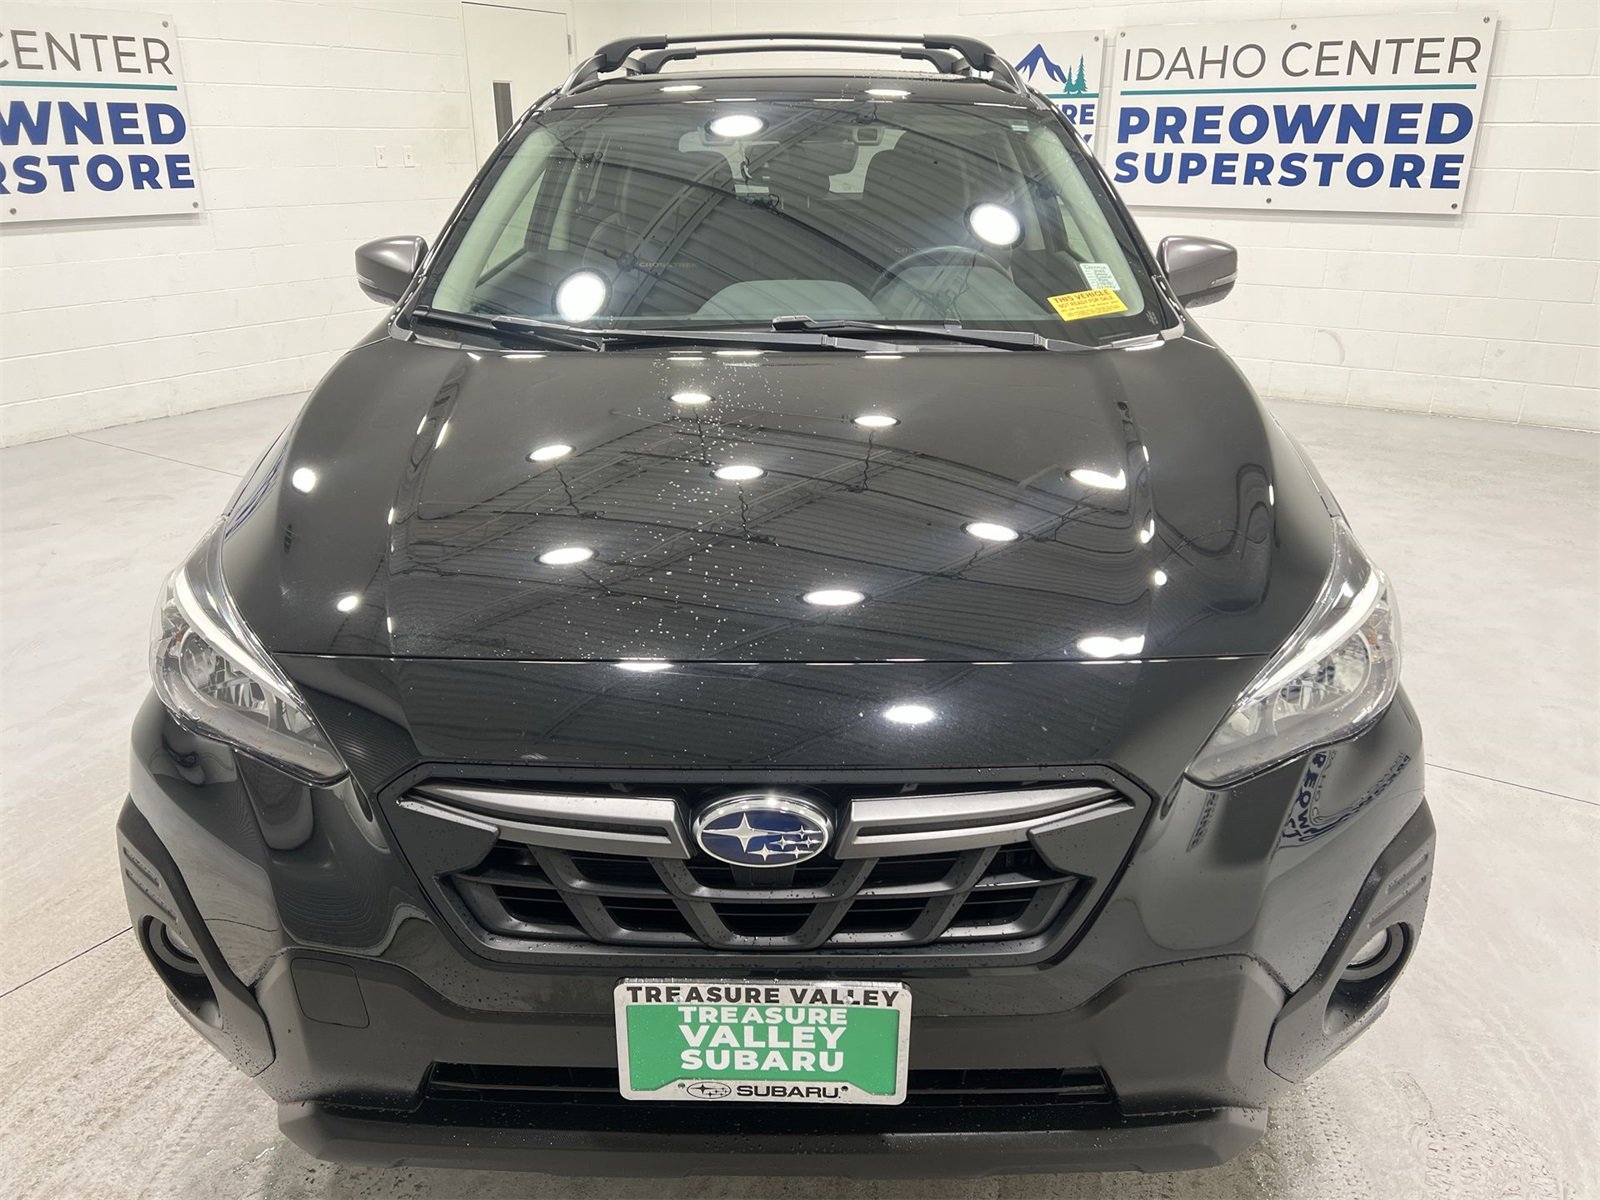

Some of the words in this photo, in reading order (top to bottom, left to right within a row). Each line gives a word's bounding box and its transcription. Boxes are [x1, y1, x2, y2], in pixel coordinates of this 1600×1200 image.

[0, 29, 173, 75] ENTER
[1123, 43, 1266, 82] IDAHO
[1281, 36, 1481, 77] CENTER
[1117, 102, 1474, 146] PREOWNED
[1114, 151, 1464, 189] SUPERSTORE
[1053, 295, 1074, 304] THIS
[1074, 288, 1111, 300] VEHICLE
[626, 986, 780, 1003] TREASURE
[790, 988, 900, 1007] VALLEY
[677, 1006, 847, 1025] TREASURE
[678, 1025, 847, 1049] VALLEY
[680, 1050, 844, 1072] SUBARU
[736, 1085, 840, 1099] SUBARU
